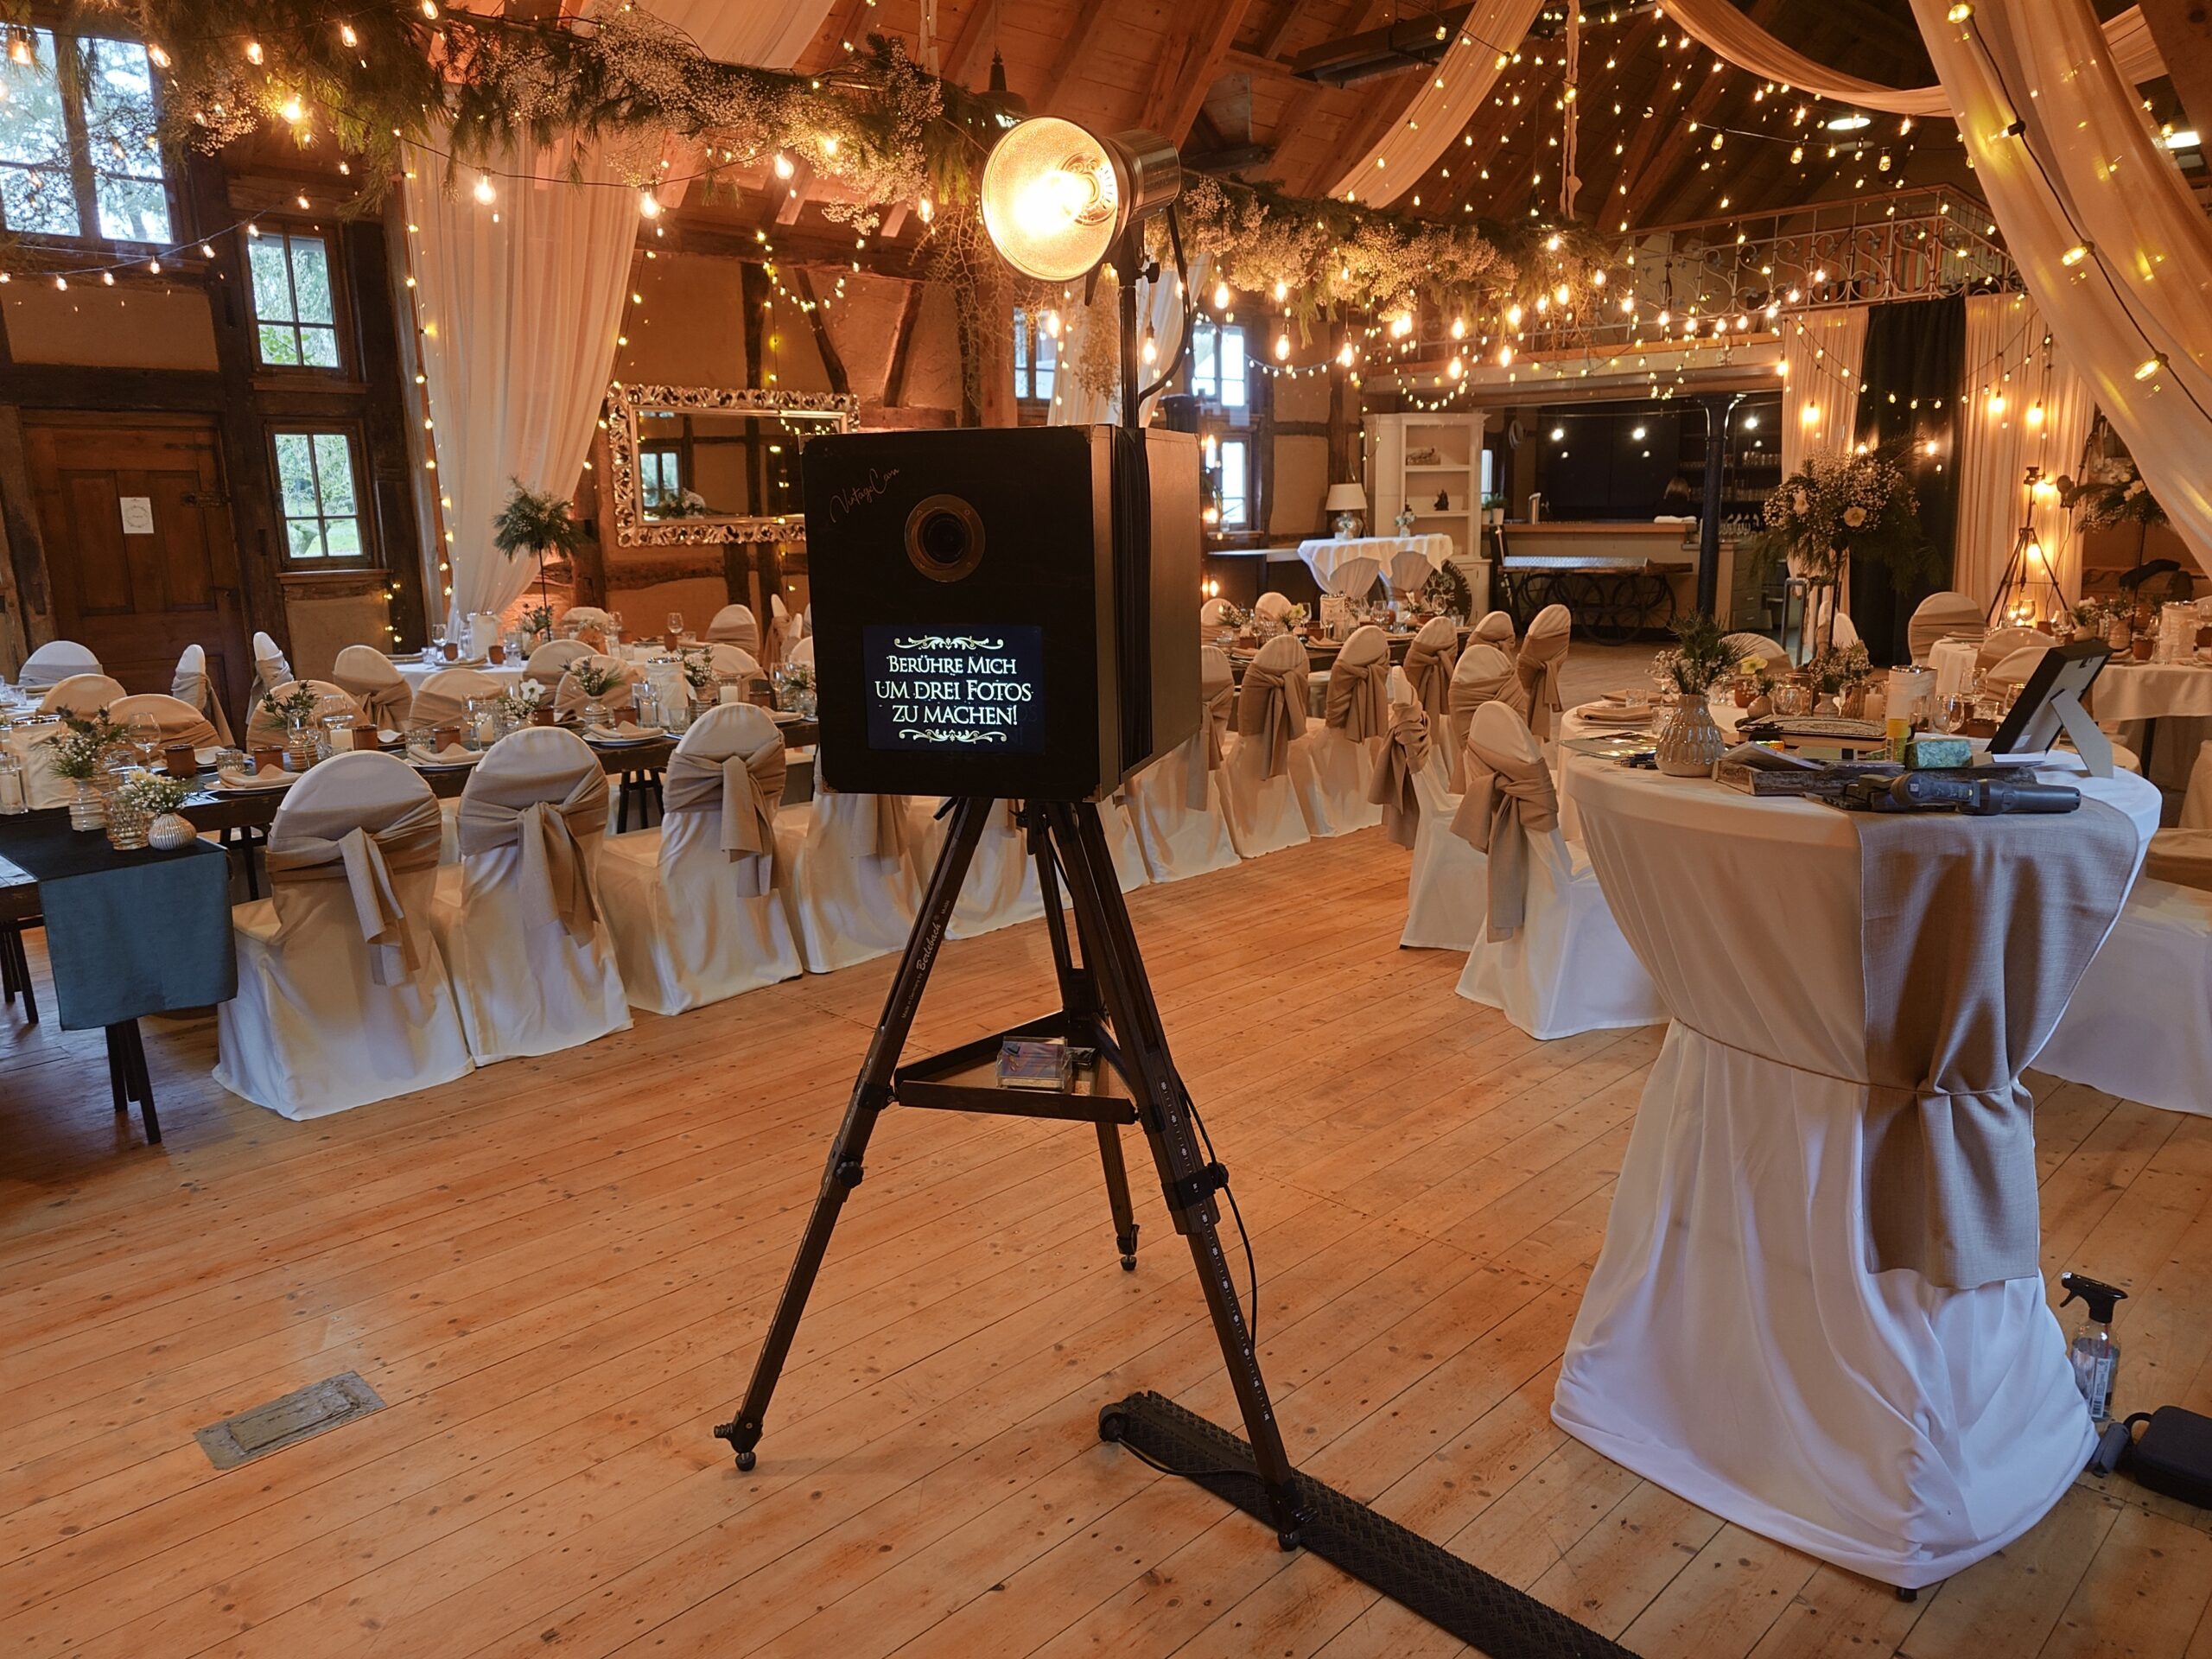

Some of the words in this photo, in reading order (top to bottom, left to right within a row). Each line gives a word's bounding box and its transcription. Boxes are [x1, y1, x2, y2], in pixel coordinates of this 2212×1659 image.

[914, 681, 960, 700] DREI
[966, 680, 1032, 702] FOTOS
[893, 704, 918, 722] ZU
[924, 704, 1018, 725] MACHEN!
